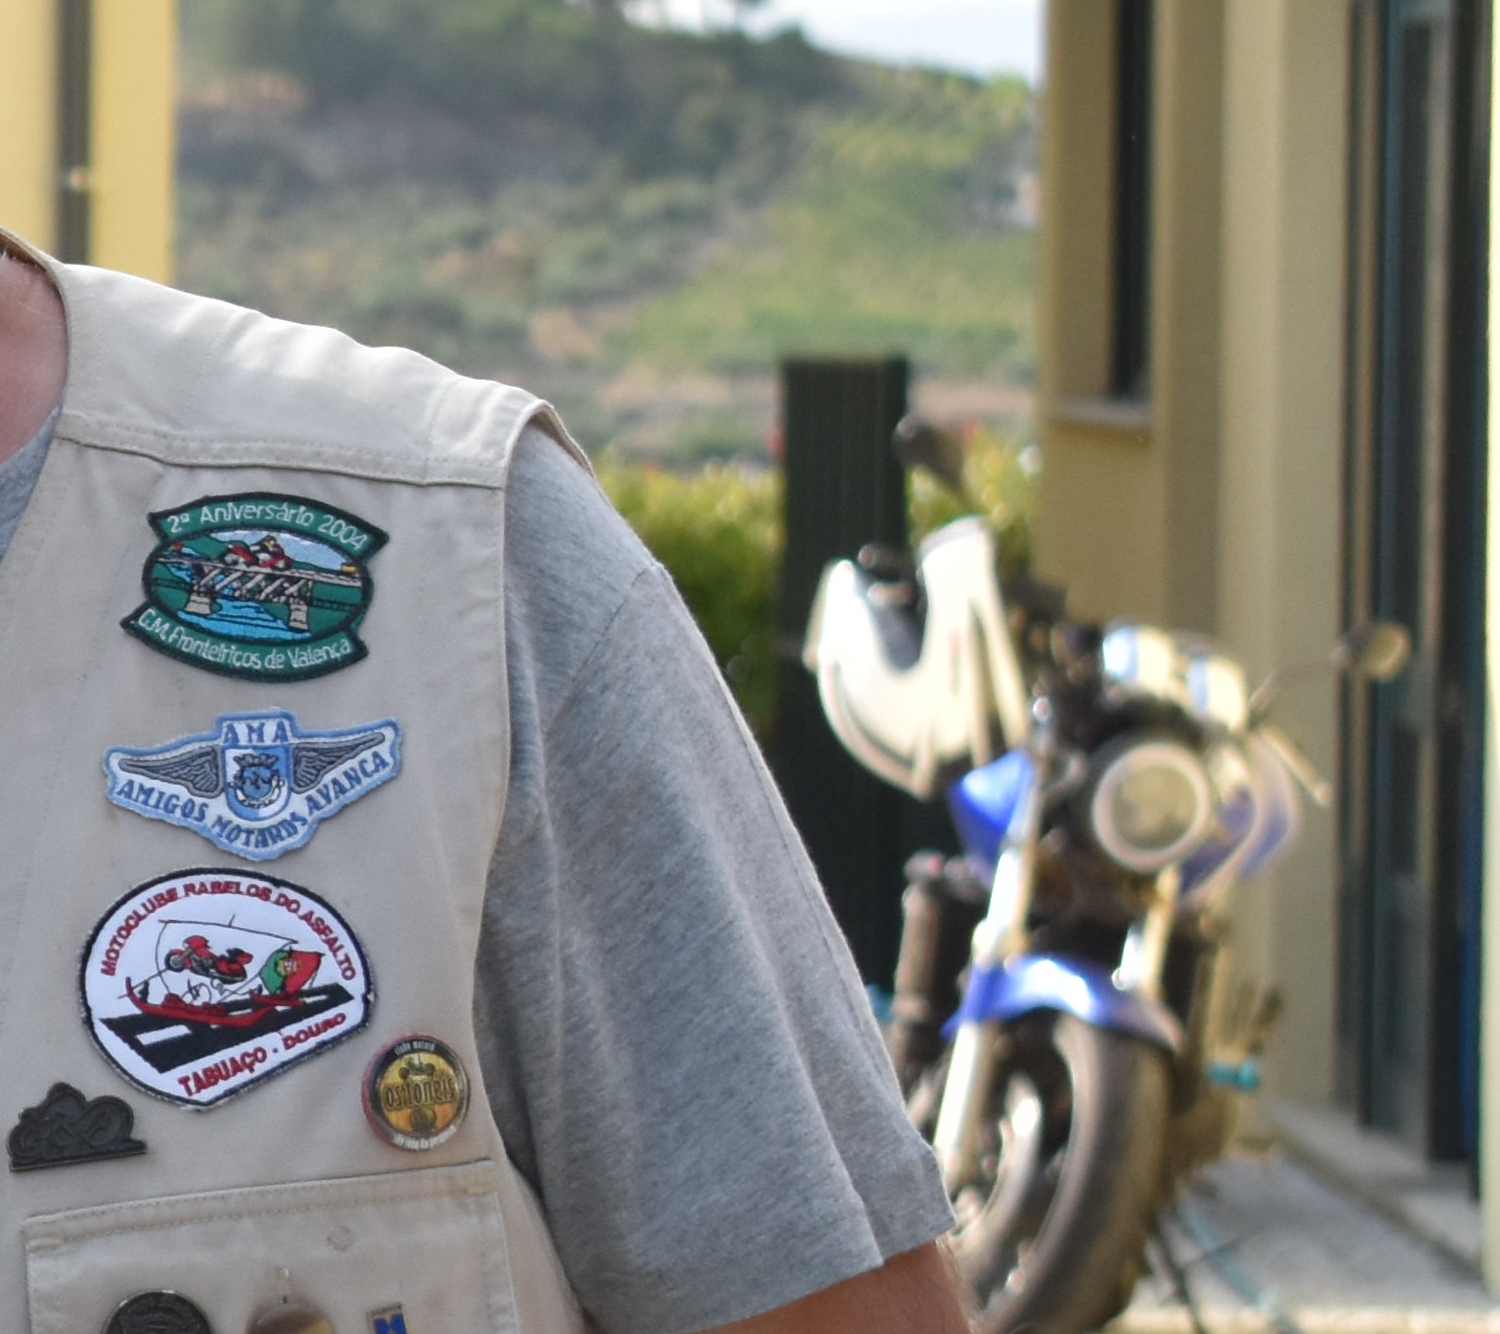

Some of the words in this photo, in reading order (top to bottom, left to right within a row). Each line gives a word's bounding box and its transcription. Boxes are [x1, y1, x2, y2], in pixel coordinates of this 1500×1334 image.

[199, 500, 314, 527] Aniversário
[318, 513, 370, 552] 2004
[265, 649, 285, 670] de
[287, 638, 353, 668] Valença
[116, 778, 209, 823] AMIGOS
[212, 813, 308, 849] MOTARDS
[305, 750, 390, 817] AVANCA
[100, 887, 178, 976] MOTOCLUBE
[183, 880, 273, 902] RABELOS
[273, 893, 301, 914] DO
[300, 909, 357, 981] ASFALTO
[177, 1046, 268, 1097] TABUAÇO
[280, 1012, 347, 1051] DOURO
